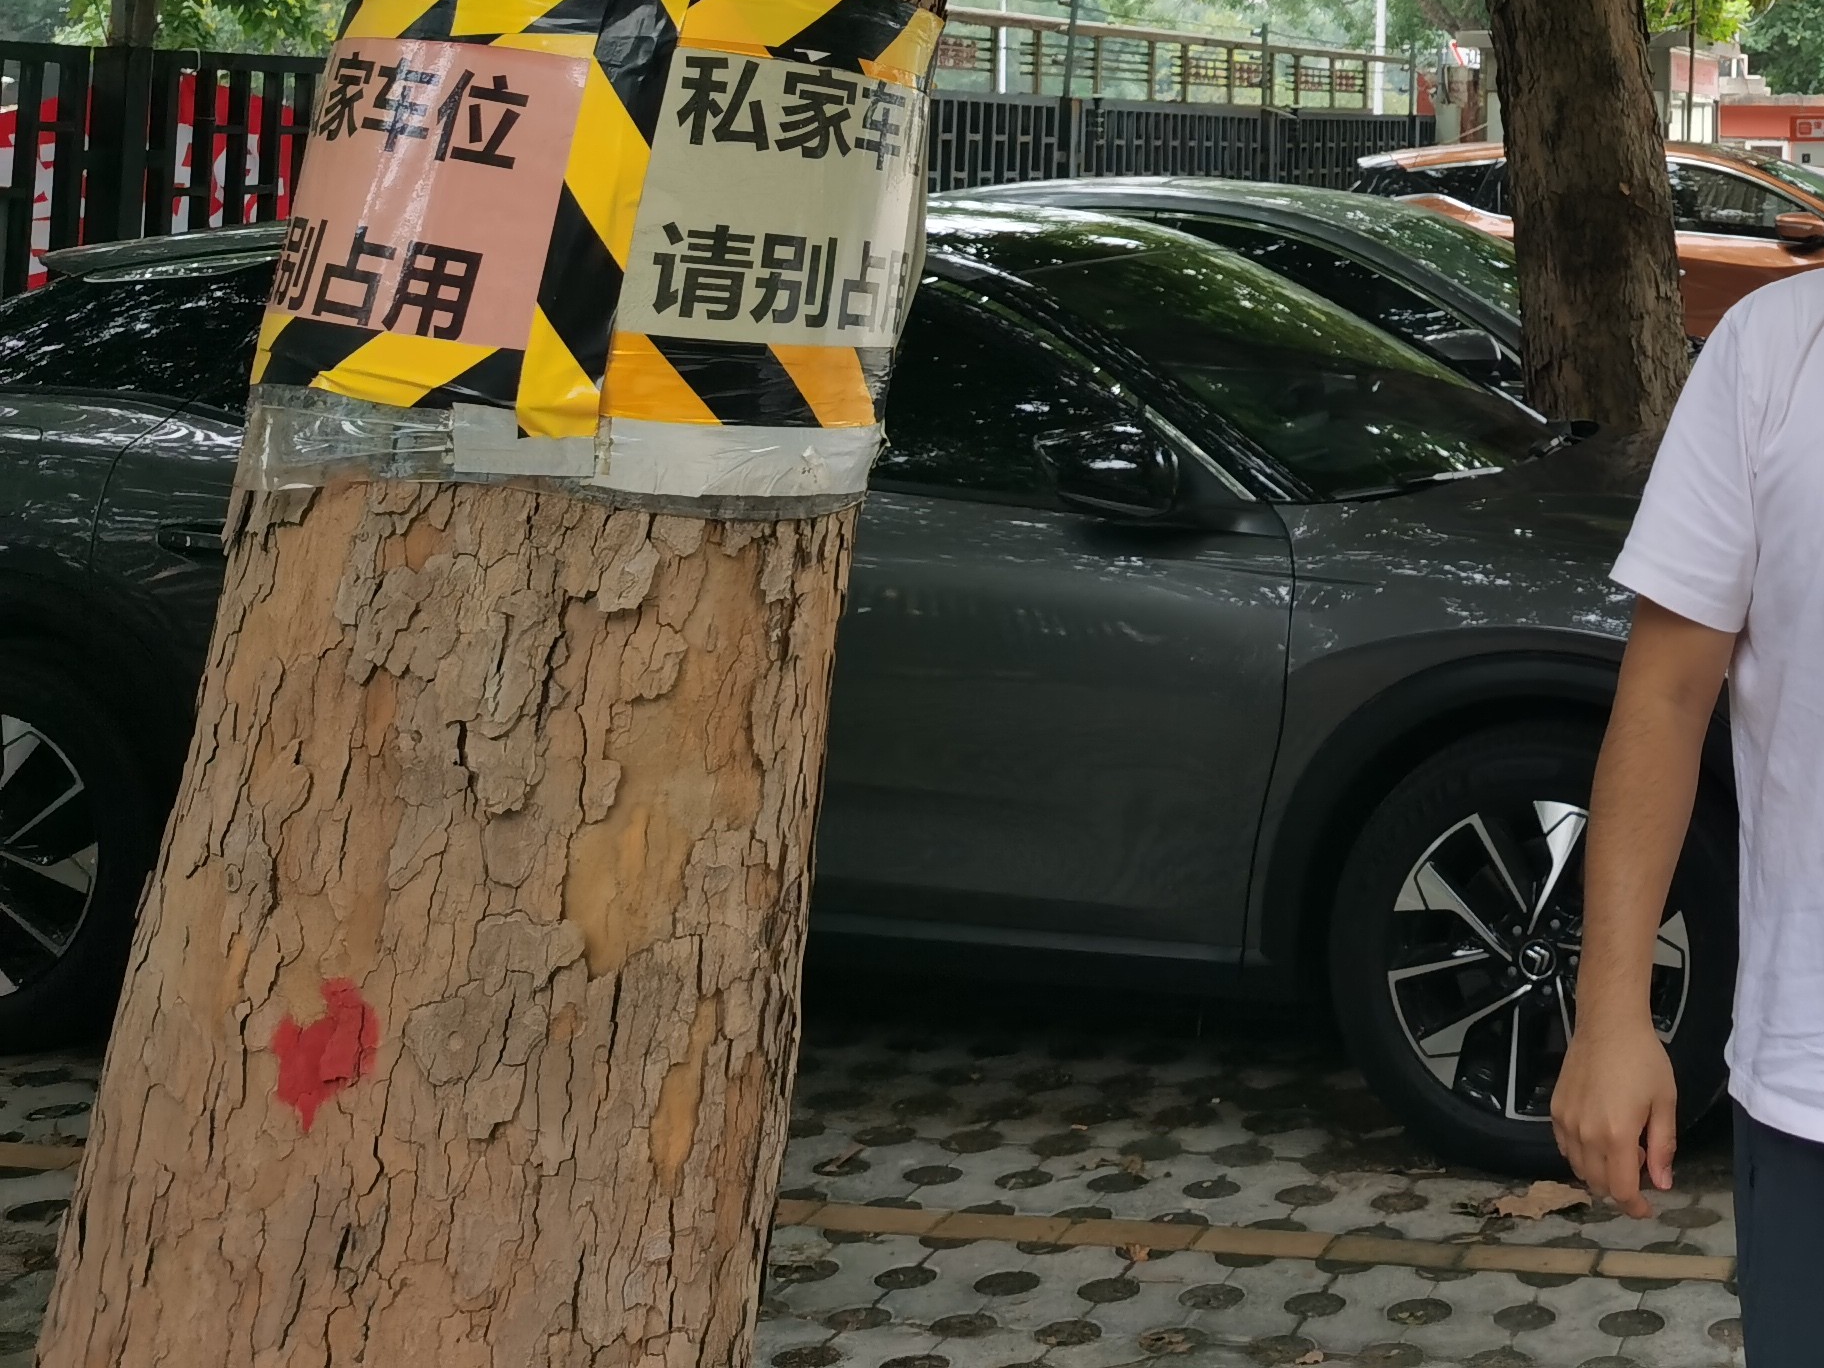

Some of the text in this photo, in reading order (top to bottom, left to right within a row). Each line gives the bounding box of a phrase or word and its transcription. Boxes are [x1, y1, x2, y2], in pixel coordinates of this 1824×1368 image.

[312, 52, 529, 169] 家车位
[272, 217, 483, 340] 别占用
[652, 221, 910, 335] 请别占用
